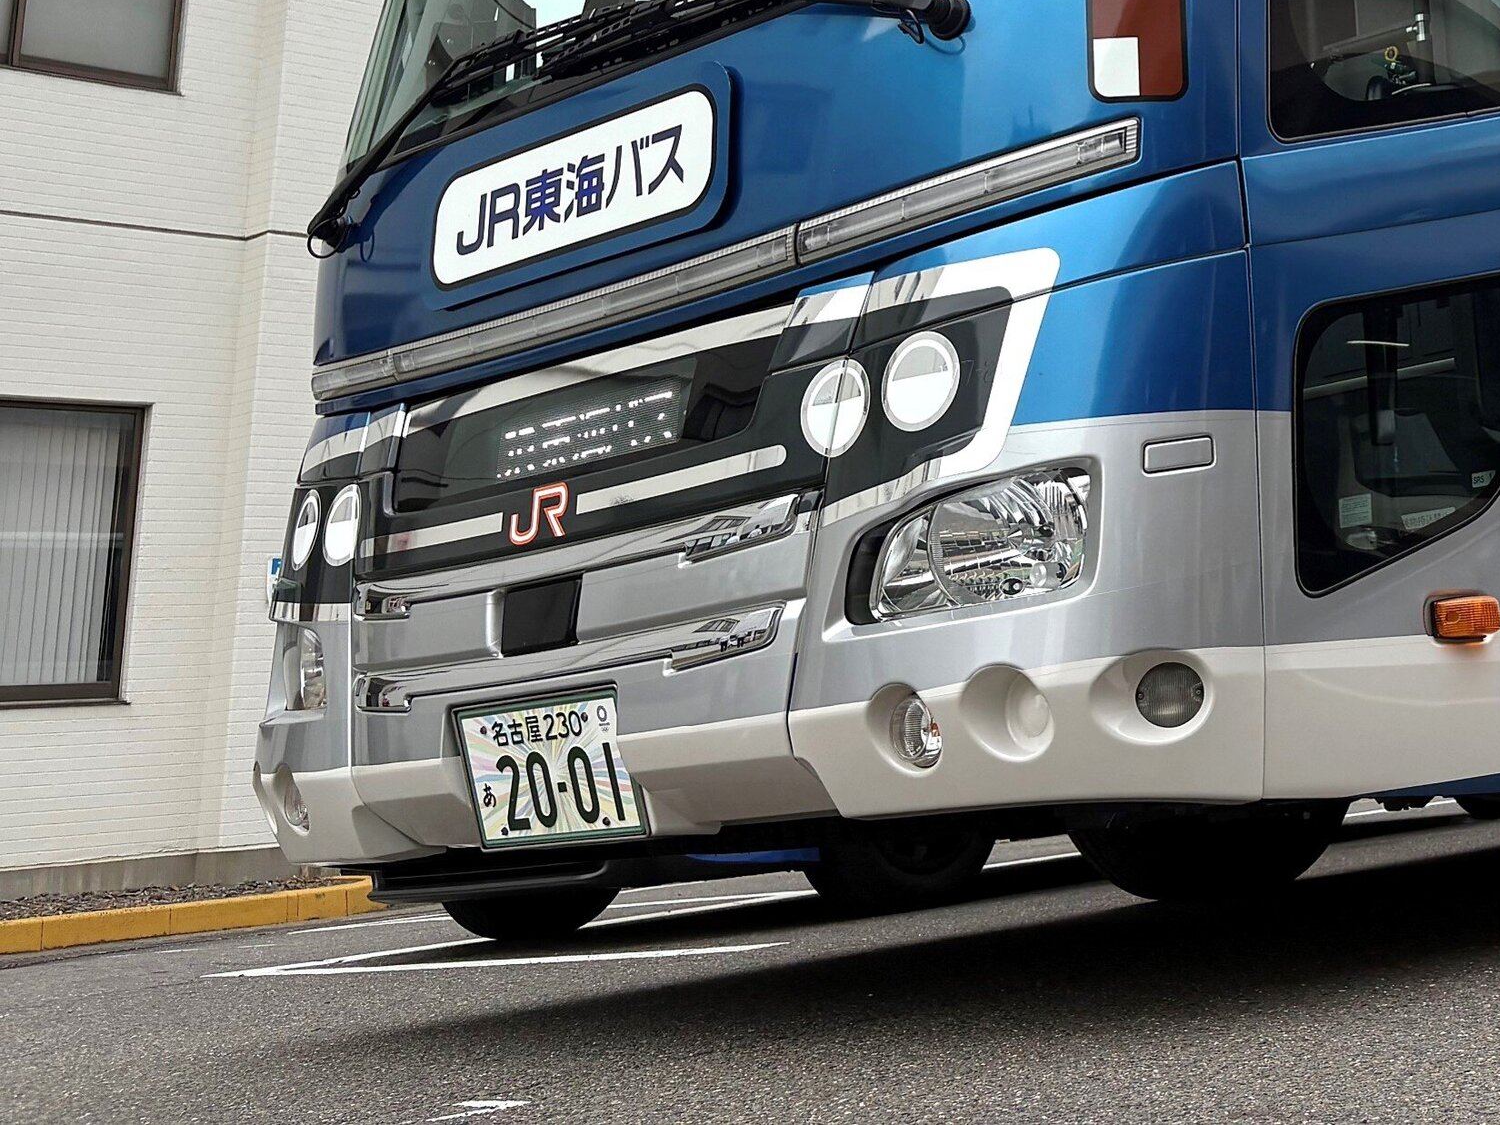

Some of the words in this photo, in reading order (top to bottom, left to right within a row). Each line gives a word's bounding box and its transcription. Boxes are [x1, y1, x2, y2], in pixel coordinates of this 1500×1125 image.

[456, 124, 684, 256] JR東海バス
[508, 481, 569, 546] JR
[482, 783, 497, 808] あ
[496, 742, 626, 831] 20-01
